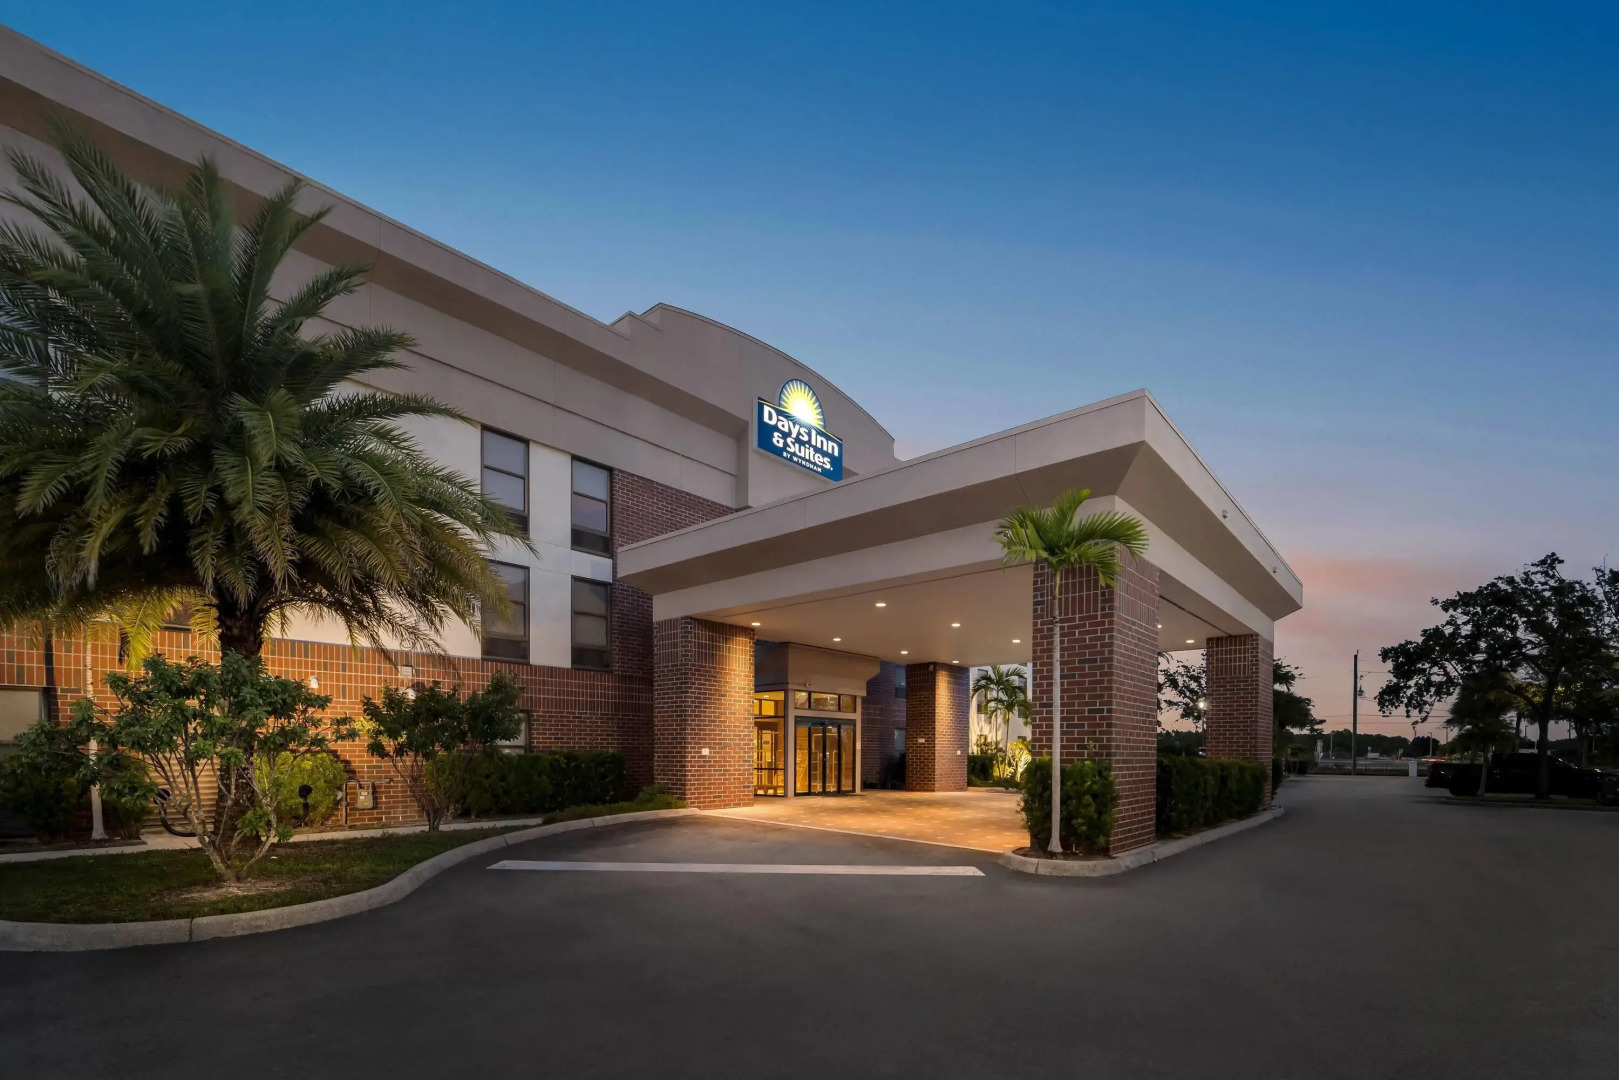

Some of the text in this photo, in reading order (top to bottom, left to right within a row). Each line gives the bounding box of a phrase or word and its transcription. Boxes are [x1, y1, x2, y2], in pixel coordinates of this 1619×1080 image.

[763, 404, 839, 457] Days Inn
[772, 431, 784, 448] &
[783, 451, 822, 473] BY WYNDHAM
